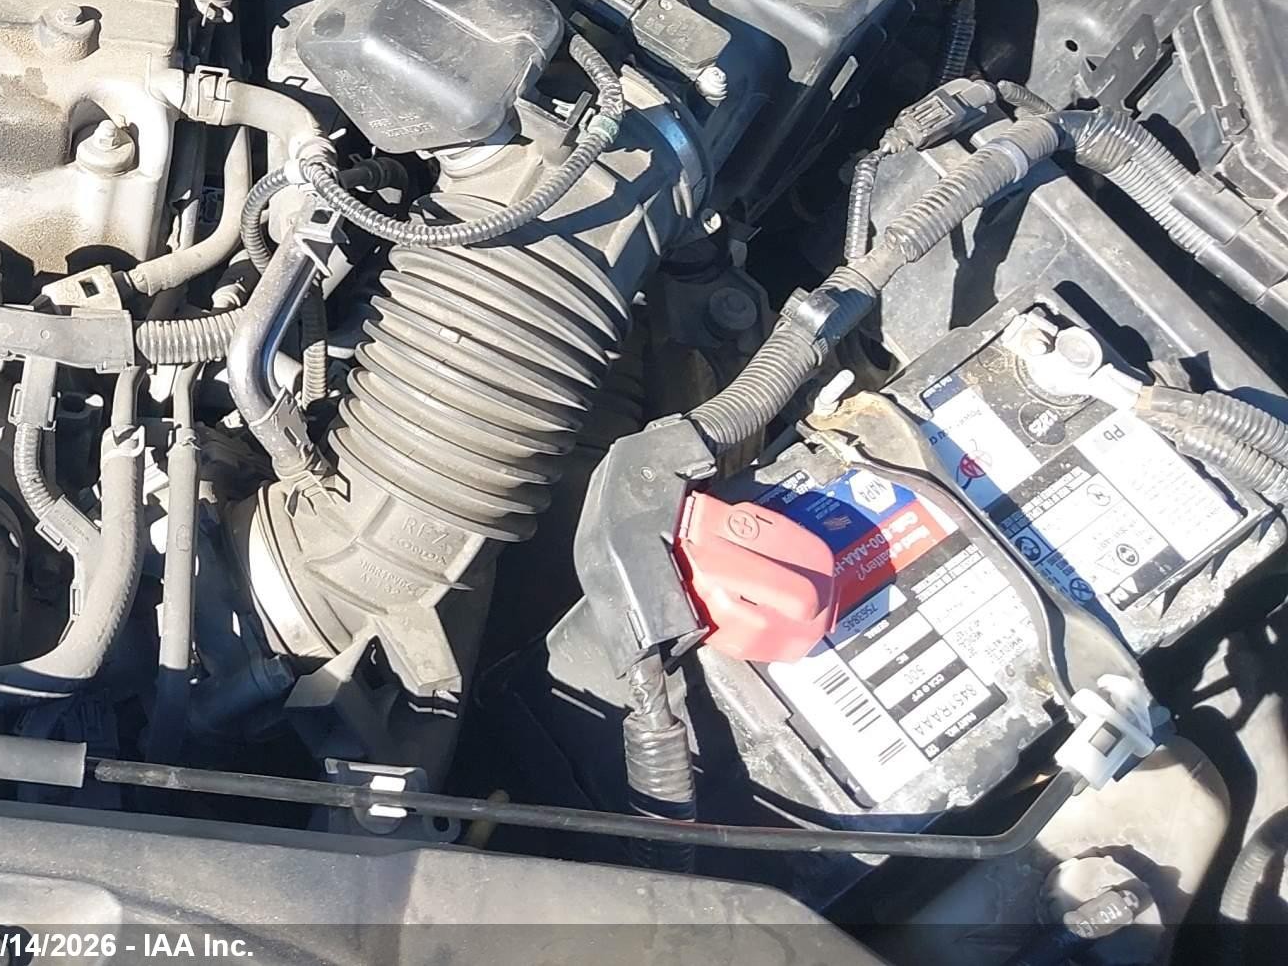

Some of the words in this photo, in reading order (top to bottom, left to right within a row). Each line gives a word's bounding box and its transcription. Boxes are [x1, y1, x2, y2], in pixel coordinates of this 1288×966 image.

[1101, 422, 1125, 445] Pb
[856, 474, 886, 505] NAPA
[840, 601, 878, 632] 7563845
